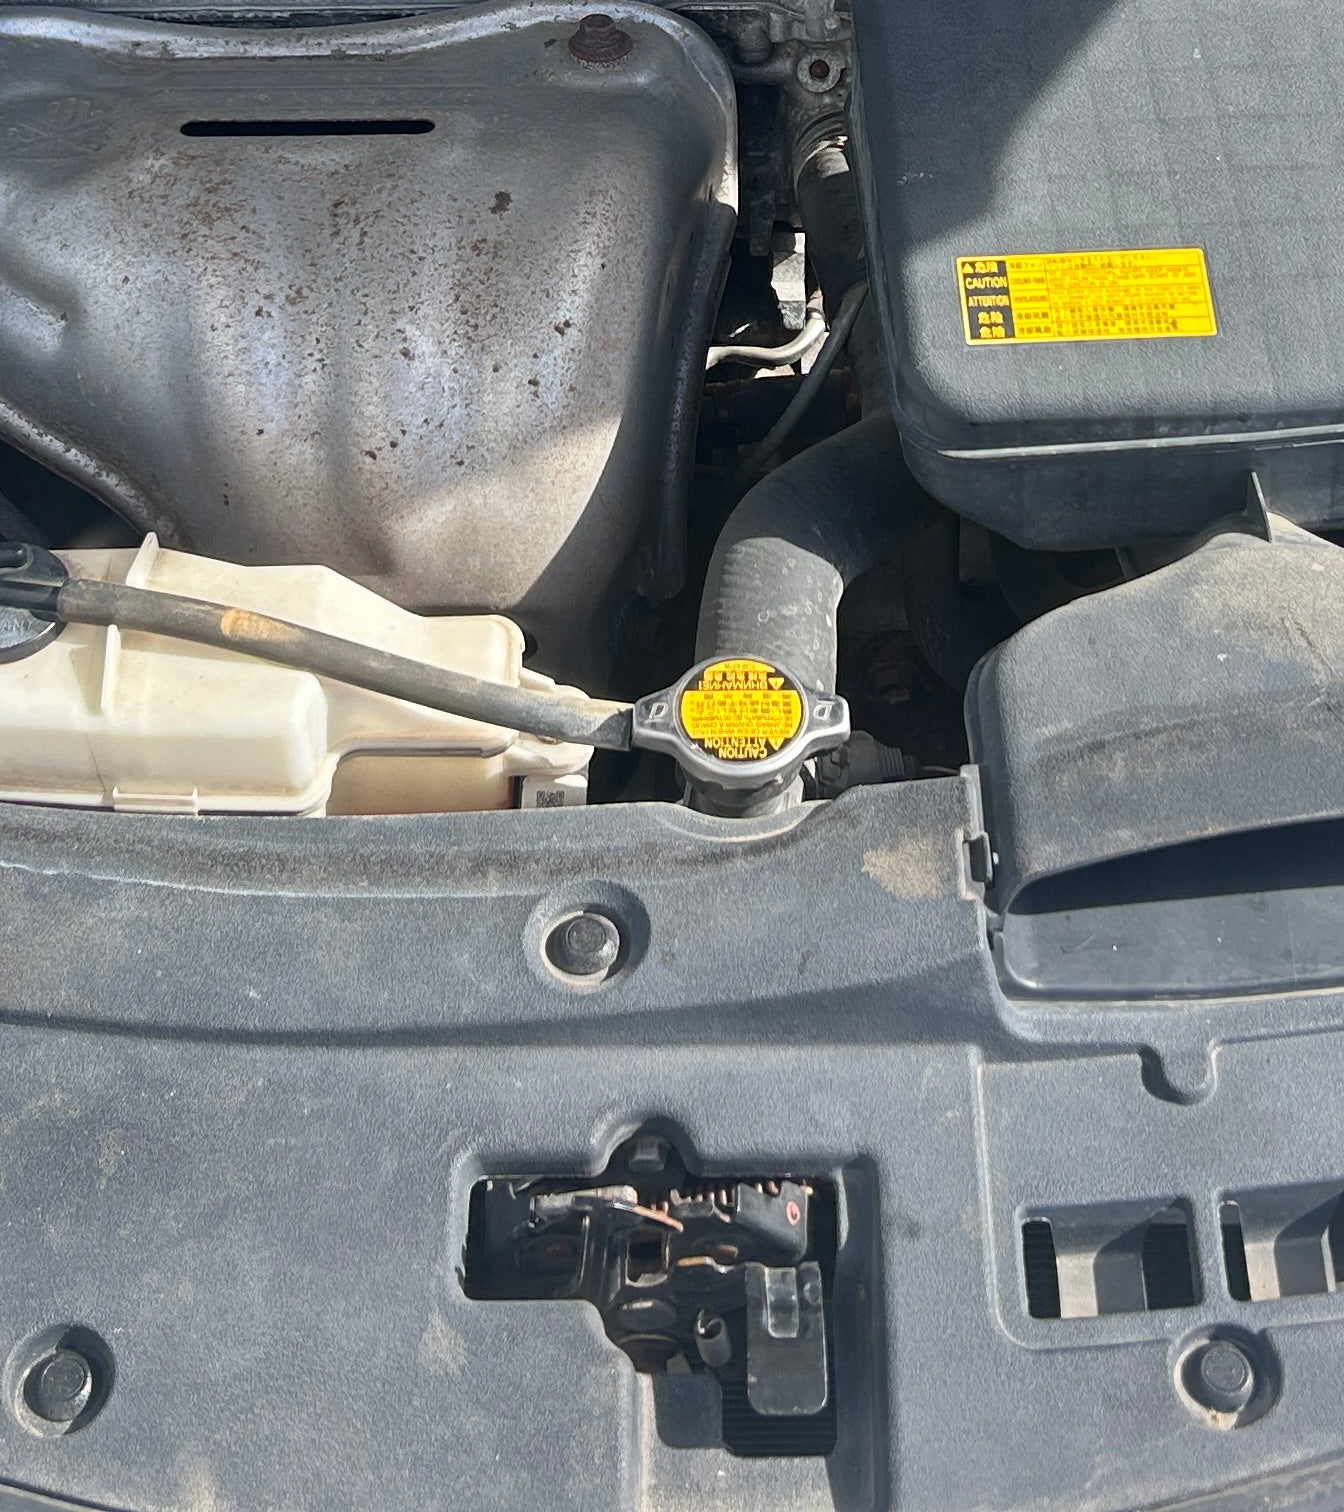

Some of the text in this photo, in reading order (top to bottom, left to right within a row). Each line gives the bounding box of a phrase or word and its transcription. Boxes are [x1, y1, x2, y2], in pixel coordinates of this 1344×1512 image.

[965, 276, 1008, 289] CAUTION
[968, 295, 1010, 308] ATTENTION
[703, 737, 766, 749] ATTENTION
[718, 747, 768, 759] CAUTION
